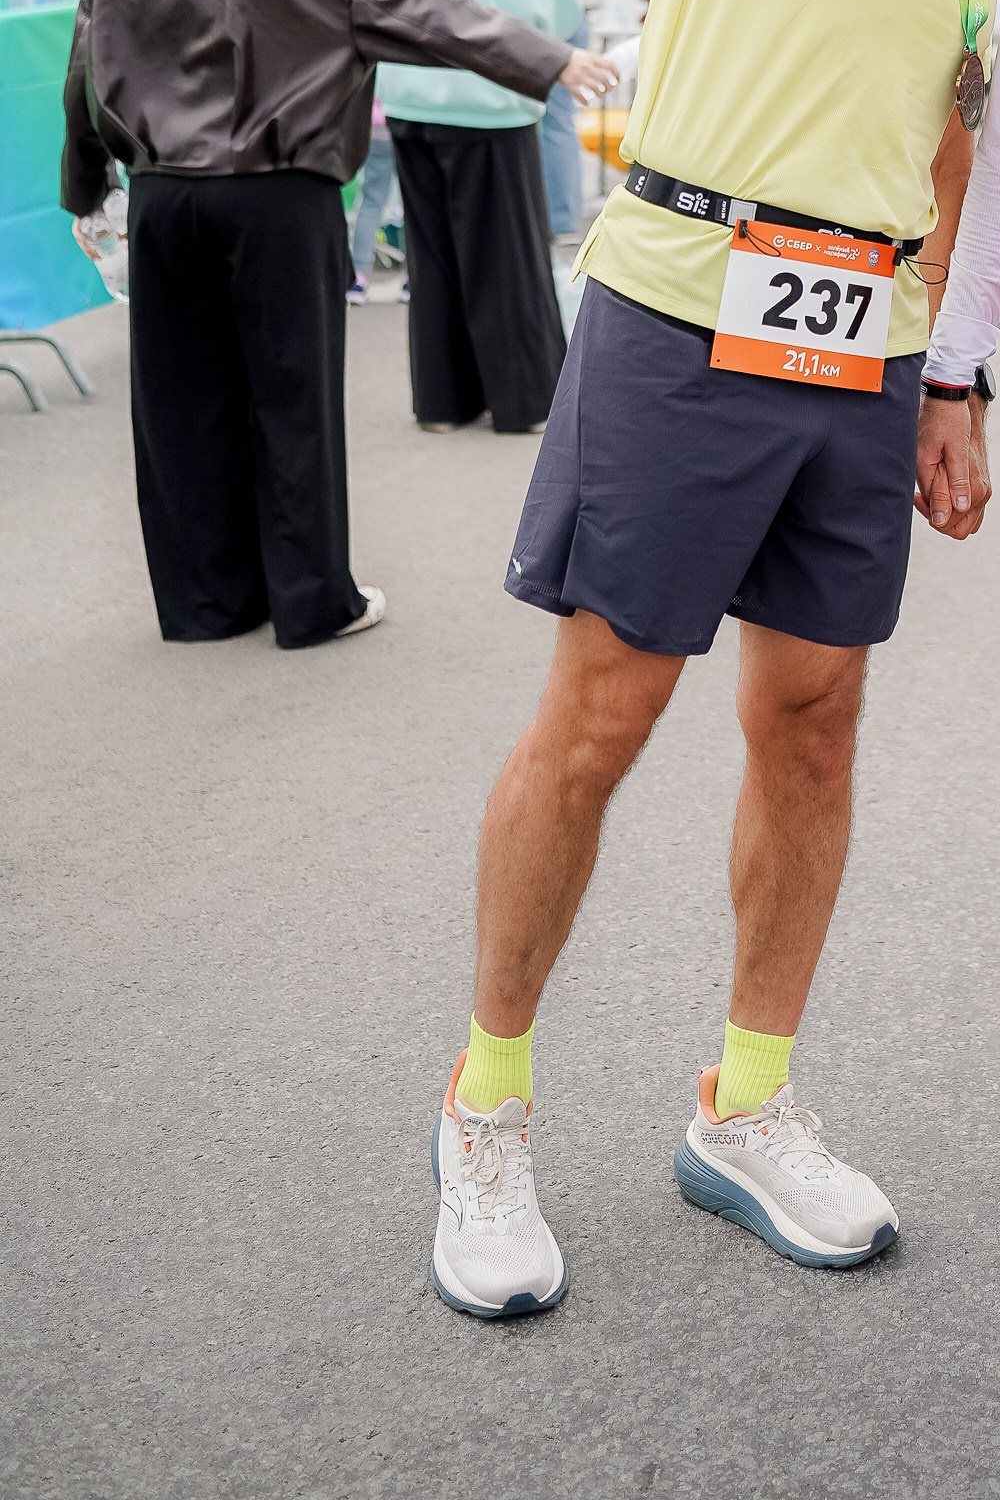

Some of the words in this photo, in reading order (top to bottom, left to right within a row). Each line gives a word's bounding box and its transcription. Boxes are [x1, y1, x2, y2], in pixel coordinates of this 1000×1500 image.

[786, 239, 813, 251] СБЕР
[761, 272, 873, 341] 237
[782, 350, 821, 378] 21,1
[701, 1132, 748, 1148] saucony
